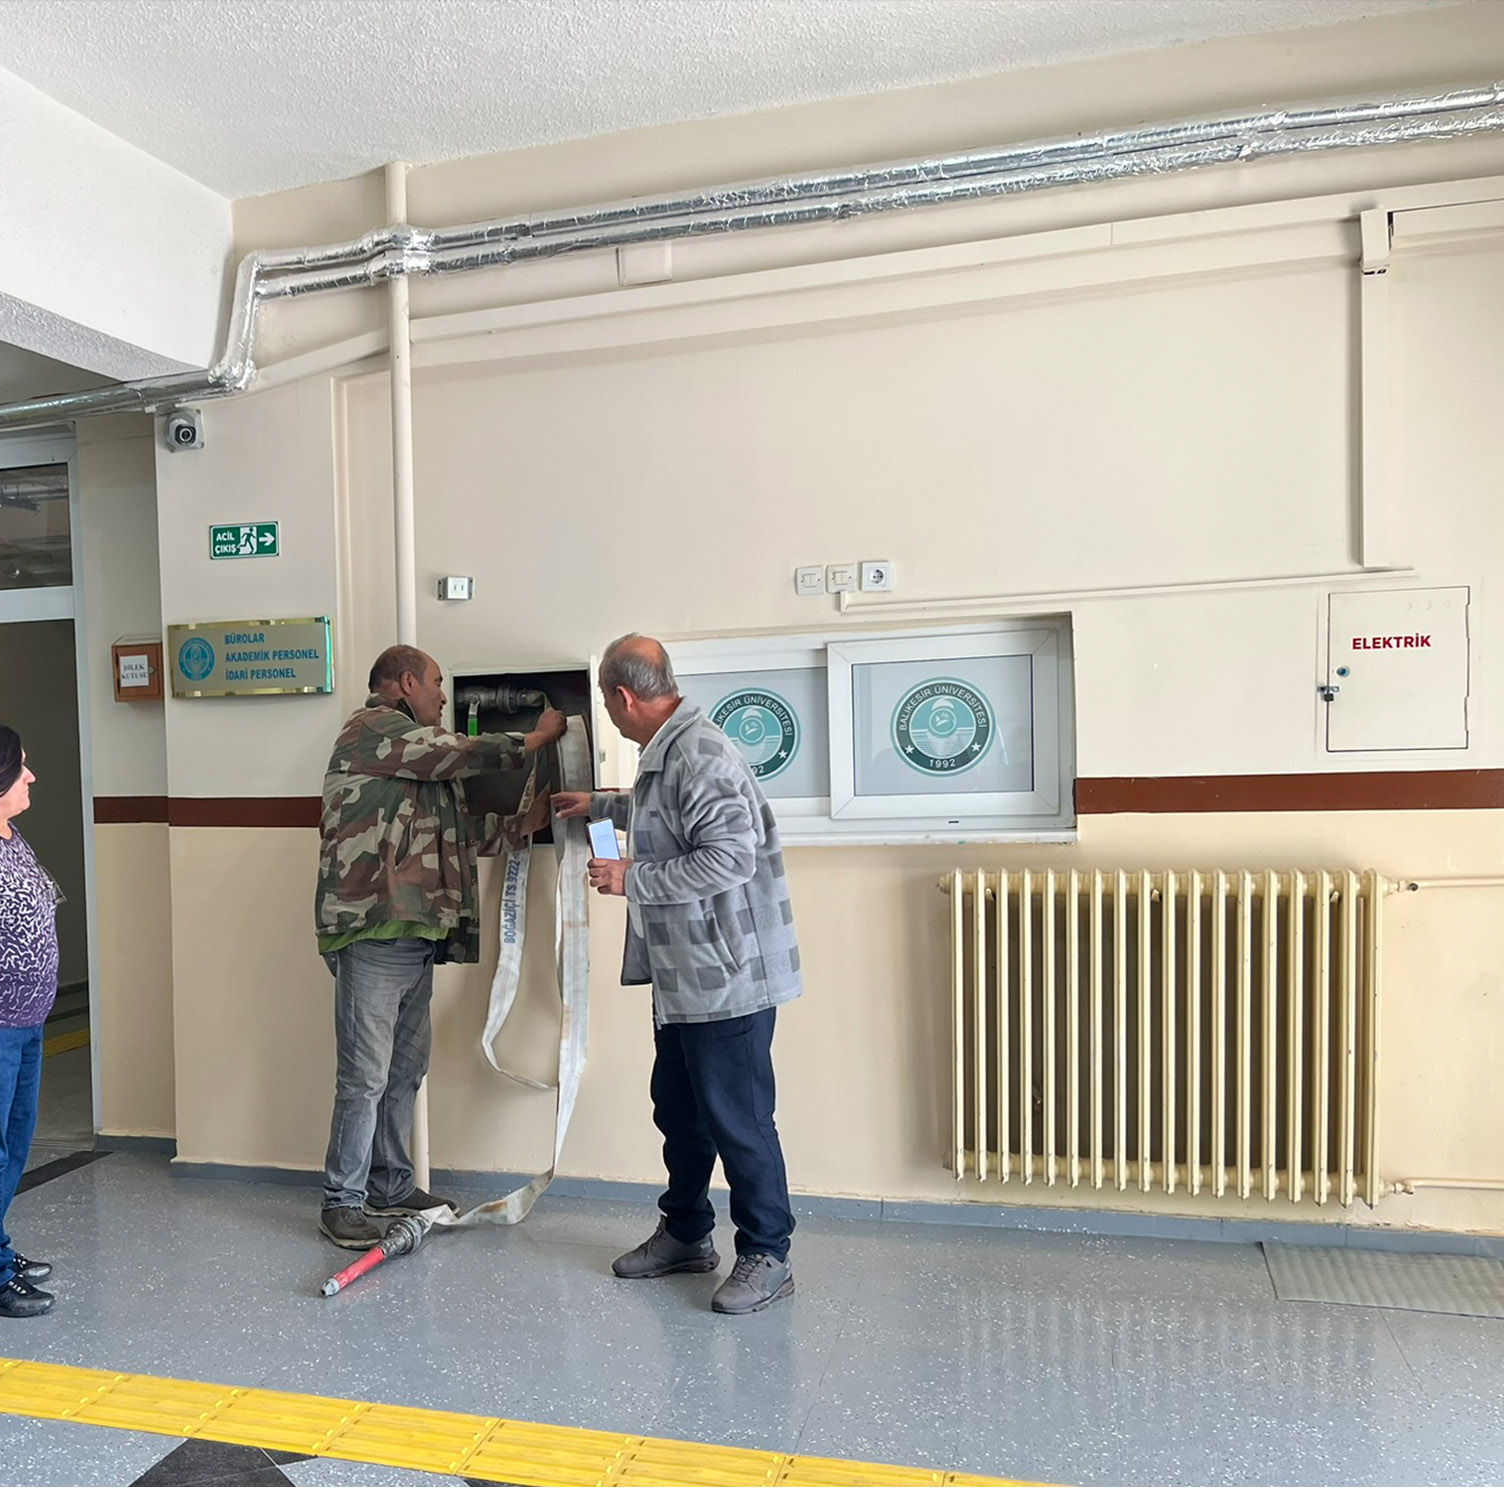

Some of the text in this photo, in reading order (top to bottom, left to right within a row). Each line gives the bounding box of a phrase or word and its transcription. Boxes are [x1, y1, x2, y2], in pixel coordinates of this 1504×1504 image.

[215, 531, 235, 542] ACİL
[214, 544, 237, 555] ÇIKIŞ
[224, 632, 265, 645] BÜROLAR
[1352, 632, 1432, 650] ELEKTRİK
[225, 648, 319, 663] AKADEMİK PERSONEL
[225, 668, 296, 681] İDARİ PERSONEL
[899, 684, 988, 731] BALIKESİR ÜNİVERSİTESİ
[752, 765, 765, 774] 92
[929, 758, 956, 769] 1992
[505, 884, 517, 897] TS
